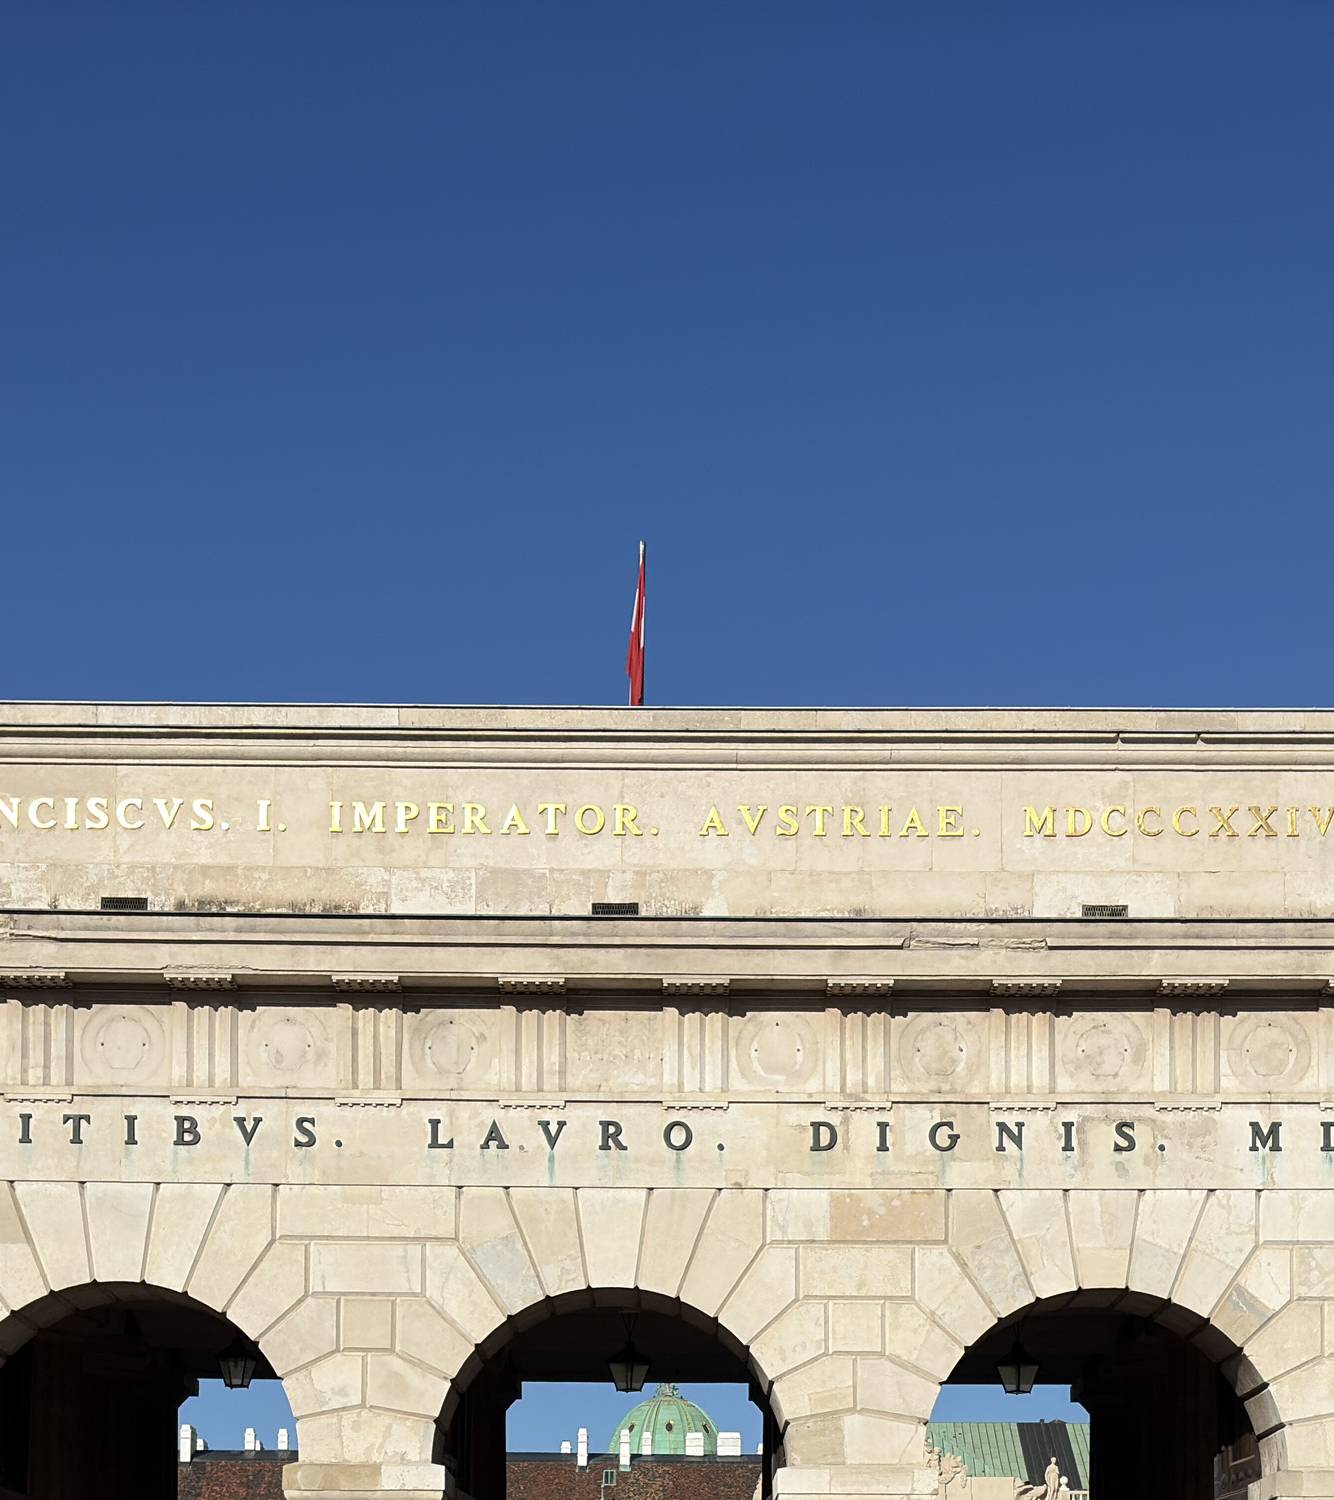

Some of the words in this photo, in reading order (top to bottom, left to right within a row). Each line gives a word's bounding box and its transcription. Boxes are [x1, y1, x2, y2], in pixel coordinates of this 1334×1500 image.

[257, 799, 286, 833] I.
[329, 800, 660, 837] IMPERATOR.
[698, 804, 981, 838] AVSTRIAE.
[428, 1117, 726, 1152] LAVRO.
[810, 1121, 1167, 1153] DIGNIS.
